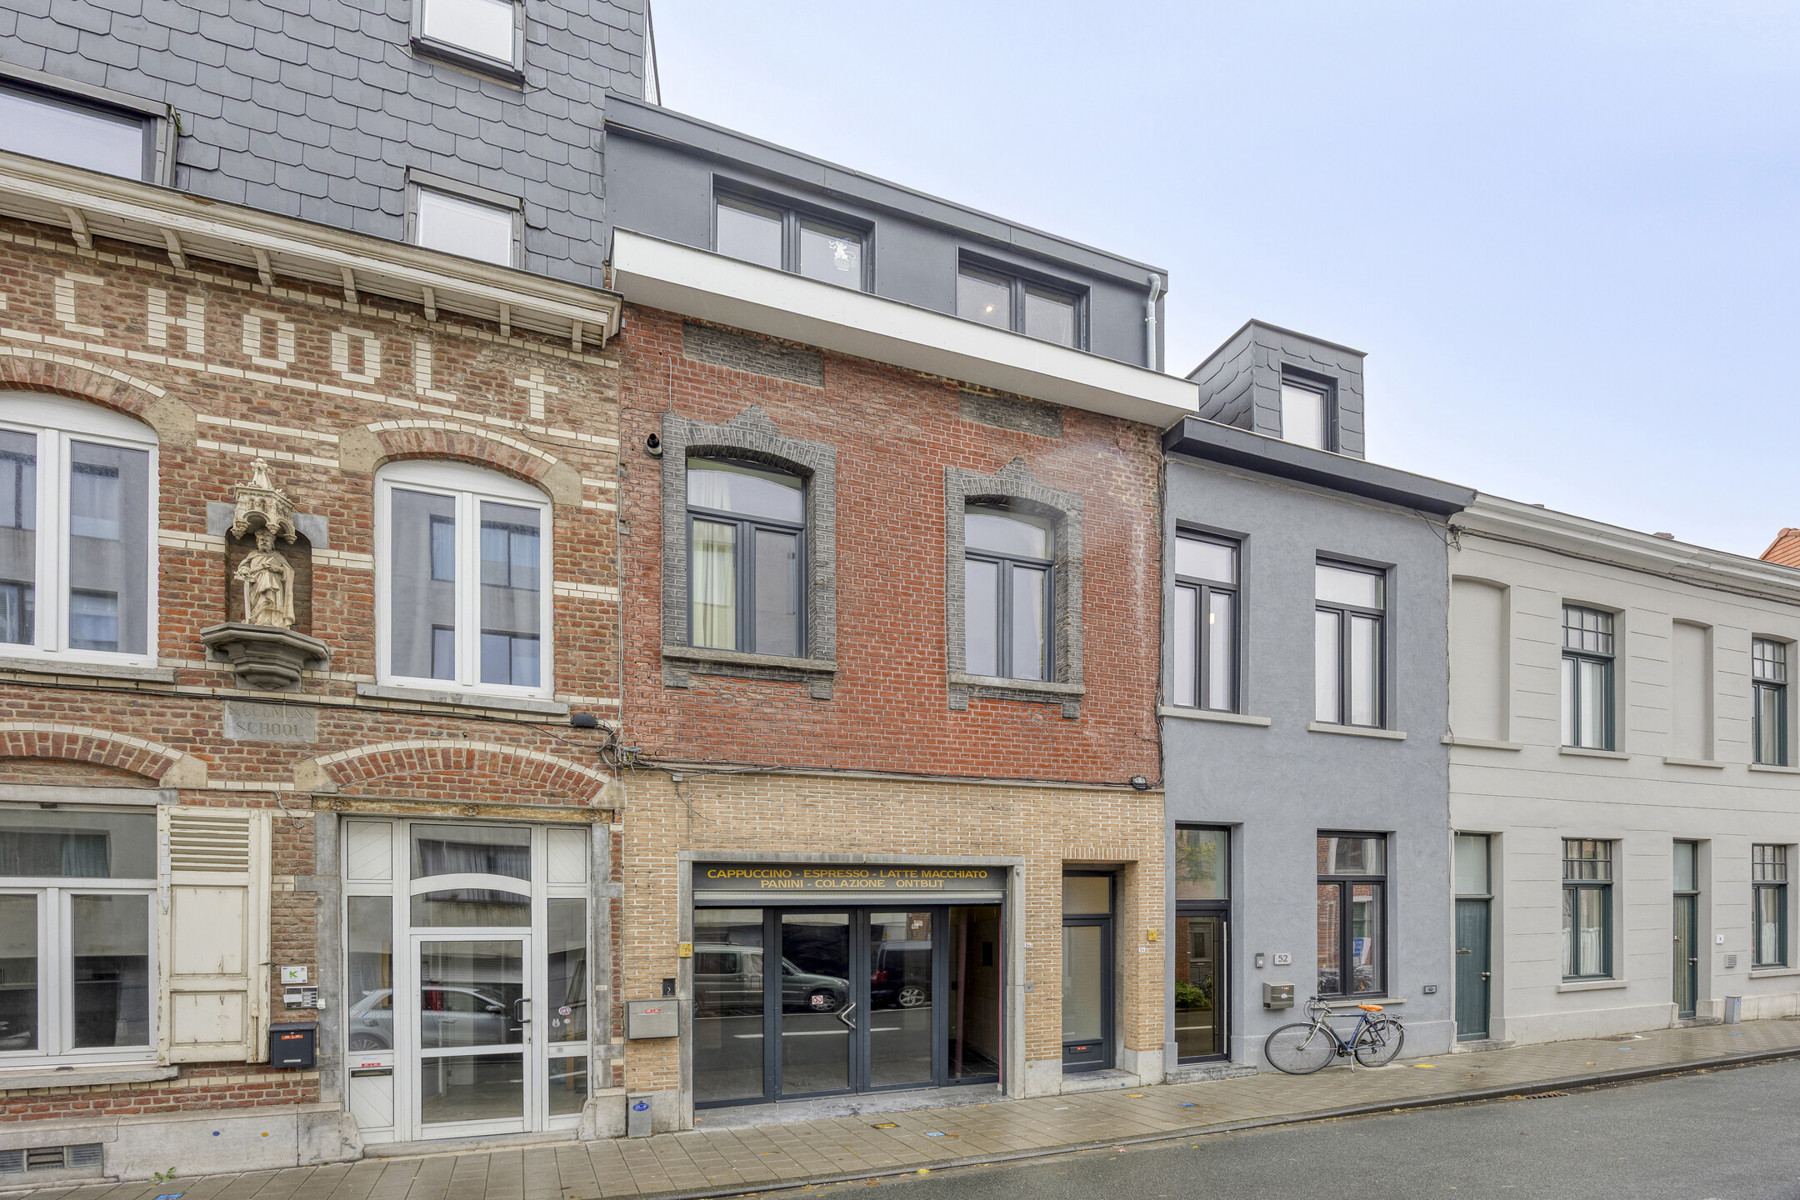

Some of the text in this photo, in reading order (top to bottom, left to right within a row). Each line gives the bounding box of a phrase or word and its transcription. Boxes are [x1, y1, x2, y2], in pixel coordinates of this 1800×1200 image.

[0, 271, 457, 402] CHOOL
[236, 721, 303, 736] SCHOOL
[707, 869, 792, 879] CAPPUCCINO
[803, 869, 869, 878] ESPRESSO
[880, 869, 918, 878] LATTE
[921, 870, 988, 879] MACCHIATO
[761, 879, 804, 888] PANINI
[815, 879, 886, 888] COLAZIONE
[1278, 954, 1288, 963] 52
